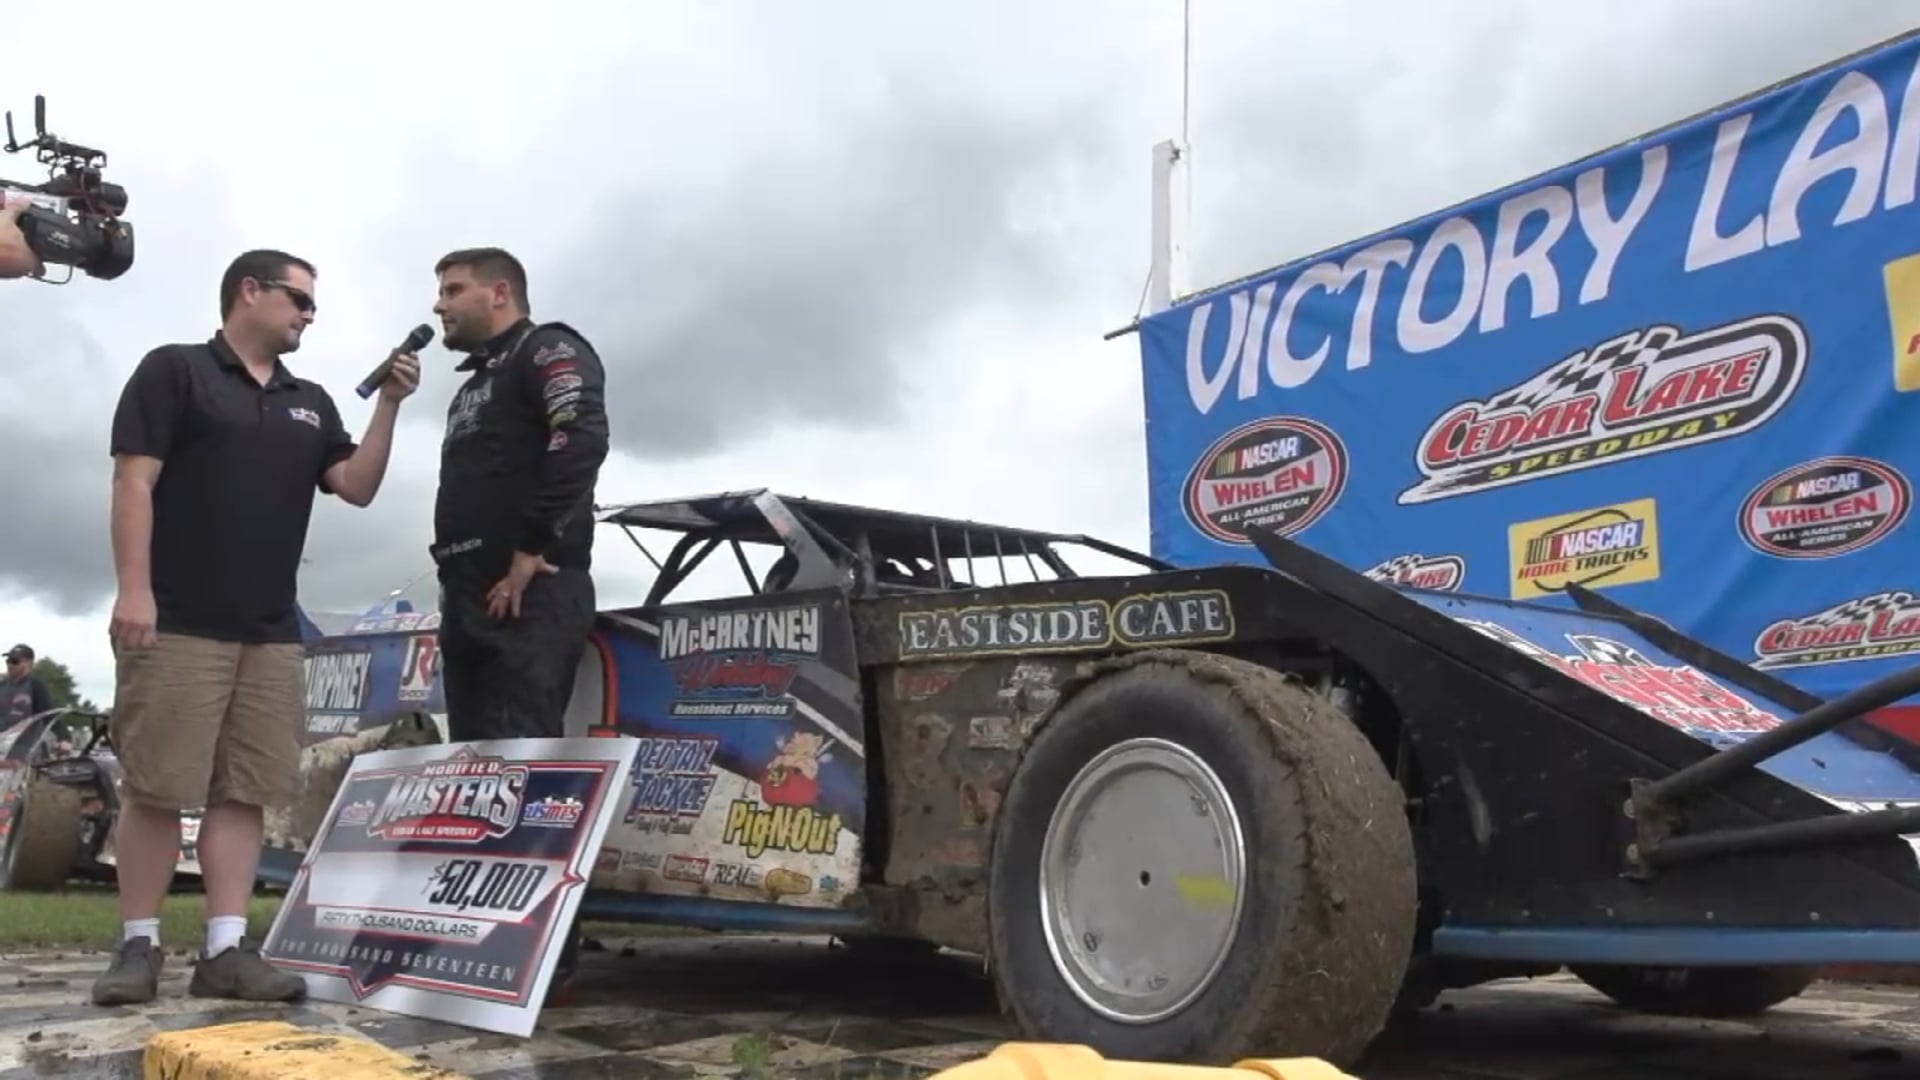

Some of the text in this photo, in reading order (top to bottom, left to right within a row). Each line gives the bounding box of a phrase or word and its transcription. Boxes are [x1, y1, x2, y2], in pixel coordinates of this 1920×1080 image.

[1185, 145, 1669, 415] VICTORY
[1425, 350, 1770, 466] CEDAR LAKE
[1240, 436, 1299, 469] NASCAR
[1488, 411, 1739, 481] SPEEDWAY
[1212, 459, 1316, 506] WHELEN
[1795, 471, 1861, 499] NASCAR
[1219, 496, 1310, 524] ALL-AMERICAN
[1766, 491, 1879, 528] WHELEN
[1559, 522, 1638, 559] NASCAR
[1771, 519, 1874, 542] ALL-AMERICAN
[1799, 532, 1848, 547] SERIES
[1517, 546, 1650, 580] HOME TRACKS
[660, 607, 819, 660] McCARTNEY
[909, 597, 1226, 649] EASTSIDE CAFE
[1760, 619, 1866, 654] CEDAR
[423, 761, 499, 777] MODIFIED
[374, 770, 526, 828] MASTERS
[624, 773, 717, 823] TACKLE
[421, 858, 548, 913] $50,000
[349, 913, 412, 931] THOUSAND
[414, 918, 479, 938] DOLLARS
[312, 942, 393, 964] THOUSAND
[401, 953, 518, 983] SEVENTEEN
